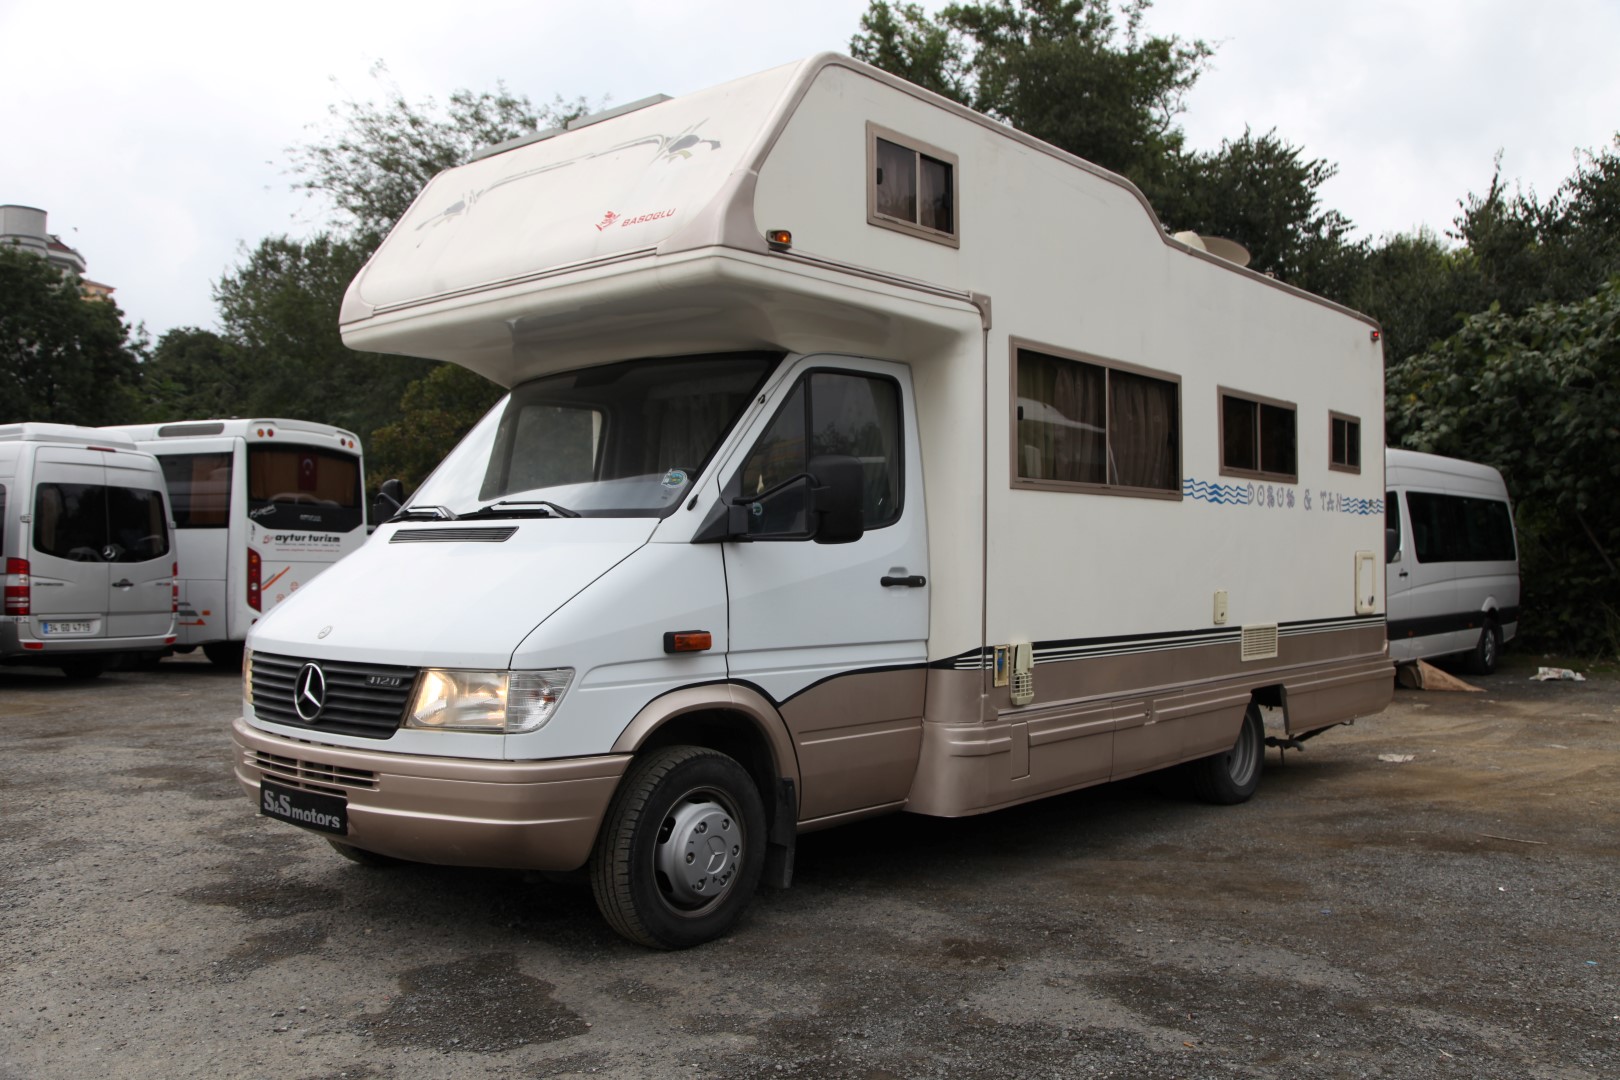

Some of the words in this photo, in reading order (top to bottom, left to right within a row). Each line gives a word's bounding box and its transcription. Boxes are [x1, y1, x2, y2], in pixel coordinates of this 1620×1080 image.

[1304, 488, 1312, 511] &
[1320, 490, 1342, 512] TAN
[275, 533, 306, 544] aytur
[308, 534, 341, 543] turizm
[48, 622, 57, 632] 34
[73, 622, 90, 632] 4719
[291, 806, 341, 829] motors
